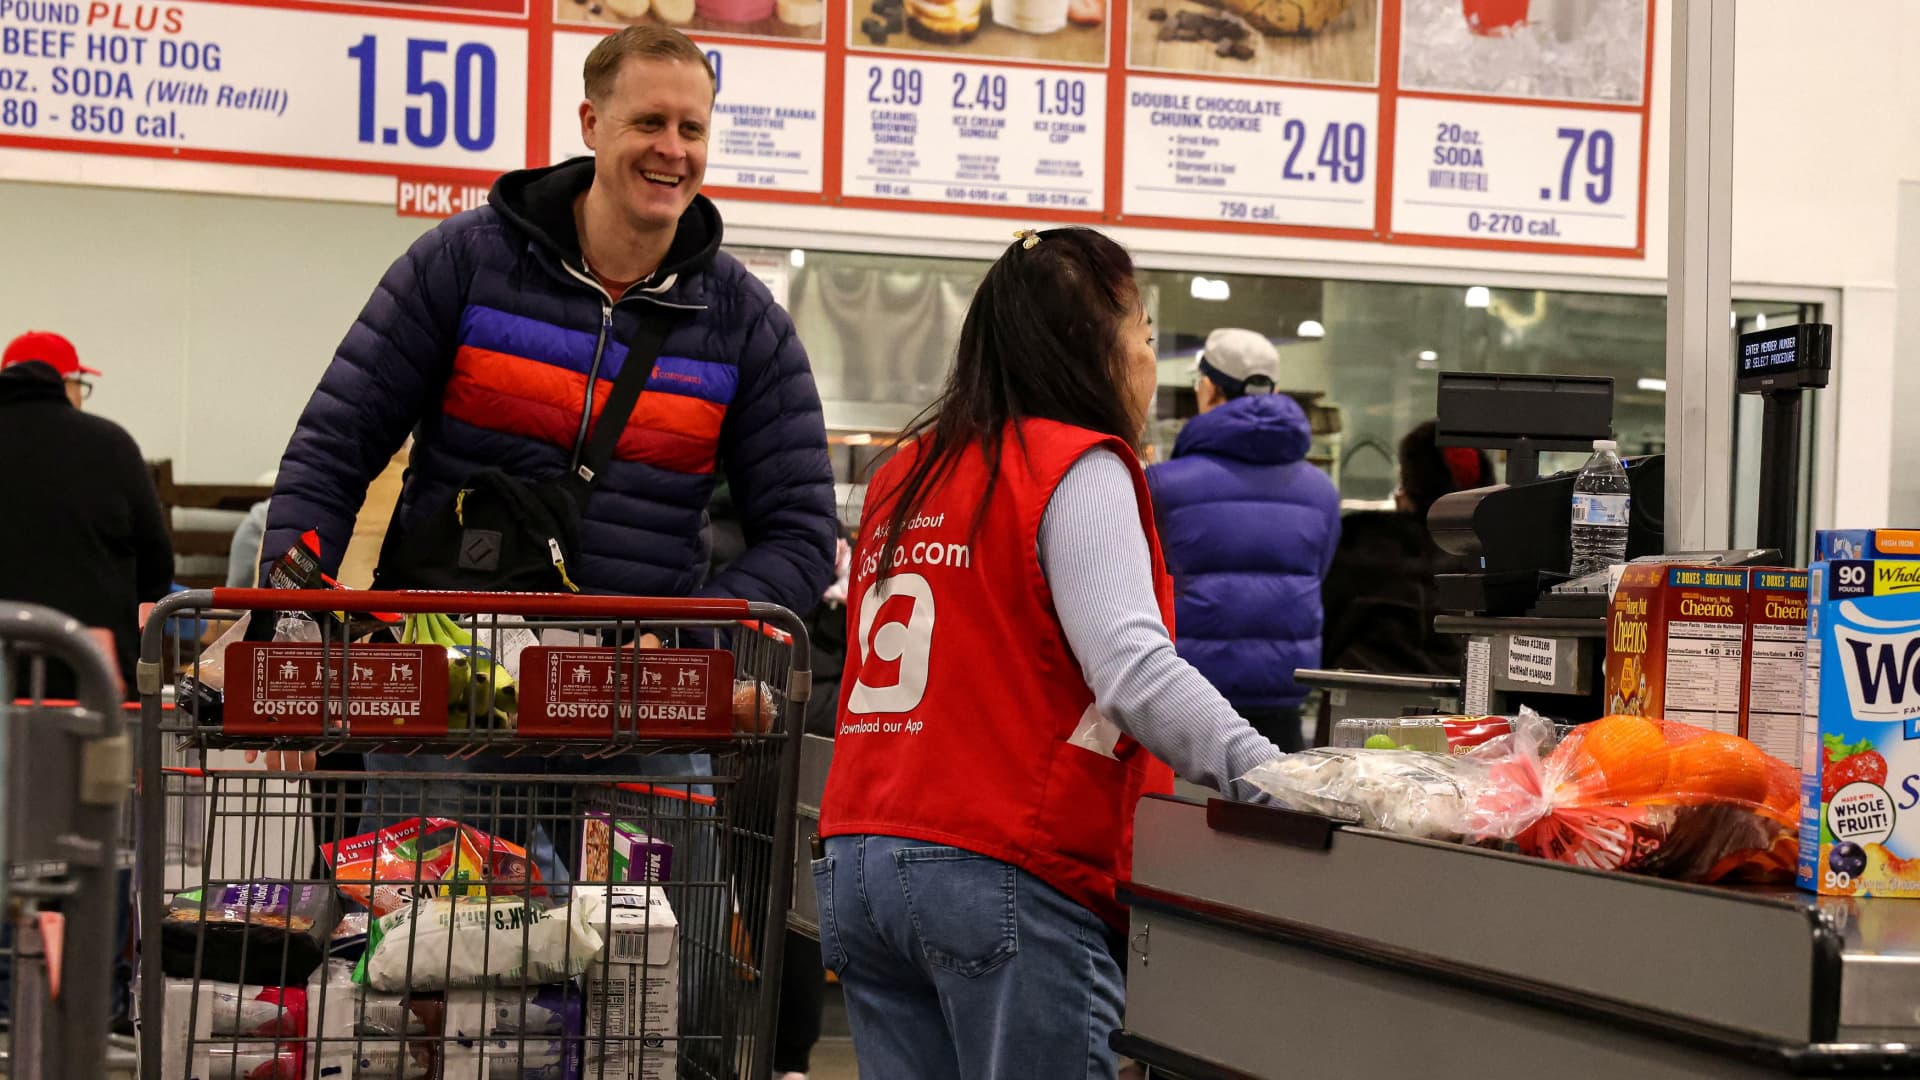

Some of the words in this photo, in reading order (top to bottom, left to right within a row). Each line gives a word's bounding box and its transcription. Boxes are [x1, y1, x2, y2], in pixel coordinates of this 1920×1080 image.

[0, 1, 79, 25] POUND
[87, 2, 183, 34] PLUS
[3, 27, 76, 59] BEEF
[88, 34, 148, 65] HOT
[159, 40, 222, 72] DOG
[51, 66, 134, 100] SODA
[146, 79, 208, 107] (With
[216, 85, 288, 117] Refill)
[347, 34, 497, 152] 1.50
[868, 65, 923, 106] 2.99
[952, 72, 1006, 112] 2.49
[1035, 77, 1085, 116] 1.99
[1131, 92, 1191, 110] DOUBLE
[1195, 96, 1282, 117] CHOCOLATE
[2, 99, 38, 128] 80
[71, 104, 124, 134] 850
[136, 112, 185, 139] cal.
[714, 104, 771, 116] RAWBERRY
[1150, 111, 1203, 129] CHUNK
[1207, 114, 1262, 132] COOKIE
[1282, 118, 1366, 184] 2.49
[1433, 145, 1484, 167] SODA
[1540, 128, 1614, 205] .79
[1219, 200, 1248, 219] 750
[1251, 203, 1280, 220] cal.
[1468, 212, 1524, 234] 0-270
[1528, 217, 1561, 237] cal.
[1745, 343, 1760, 356] ENTER
[1761, 340, 1777, 353] MEMBER
[1778, 336, 1796, 350] NUMBER
[1744, 358, 1751, 369] OR
[1752, 355, 1769, 368] SELECT
[1770, 350, 1796, 365] PROCEDURE
[908, 512, 944, 530] about
[857, 541, 970, 582] Costo.com
[1676, 572, 1681, 584] 2
[1682, 572, 1700, 585] BOXES
[1705, 573, 1722, 585] GREAT
[1724, 574, 1742, 587] VALUE
[1761, 574, 1766, 586] 2
[1767, 575, 1785, 587] BOXES
[1790, 575, 1808, 588] GREAT
[1838, 566, 1866, 585] 90
[1838, 585, 1865, 593] POUCHES
[1680, 600, 1734, 617] Cheerios
[1765, 602, 1808, 620] Cheeri
[1613, 610, 1648, 655] Cheerios
[1704, 648, 1720, 656] 140
[256, 656, 265, 699] WARNING
[253, 701, 319, 715] COSTCO
[546, 703, 609, 718] COSTCO
[883, 721, 902, 733] our
[904, 718, 923, 735] App
[1859, 793, 1874, 801] WITH
[1834, 799, 1885, 819] WHOLE
[1837, 813, 1888, 834] FRUIT!
[336, 851, 346, 864] 4
[347, 851, 359, 860] LB
[1825, 872, 1849, 889] 90
